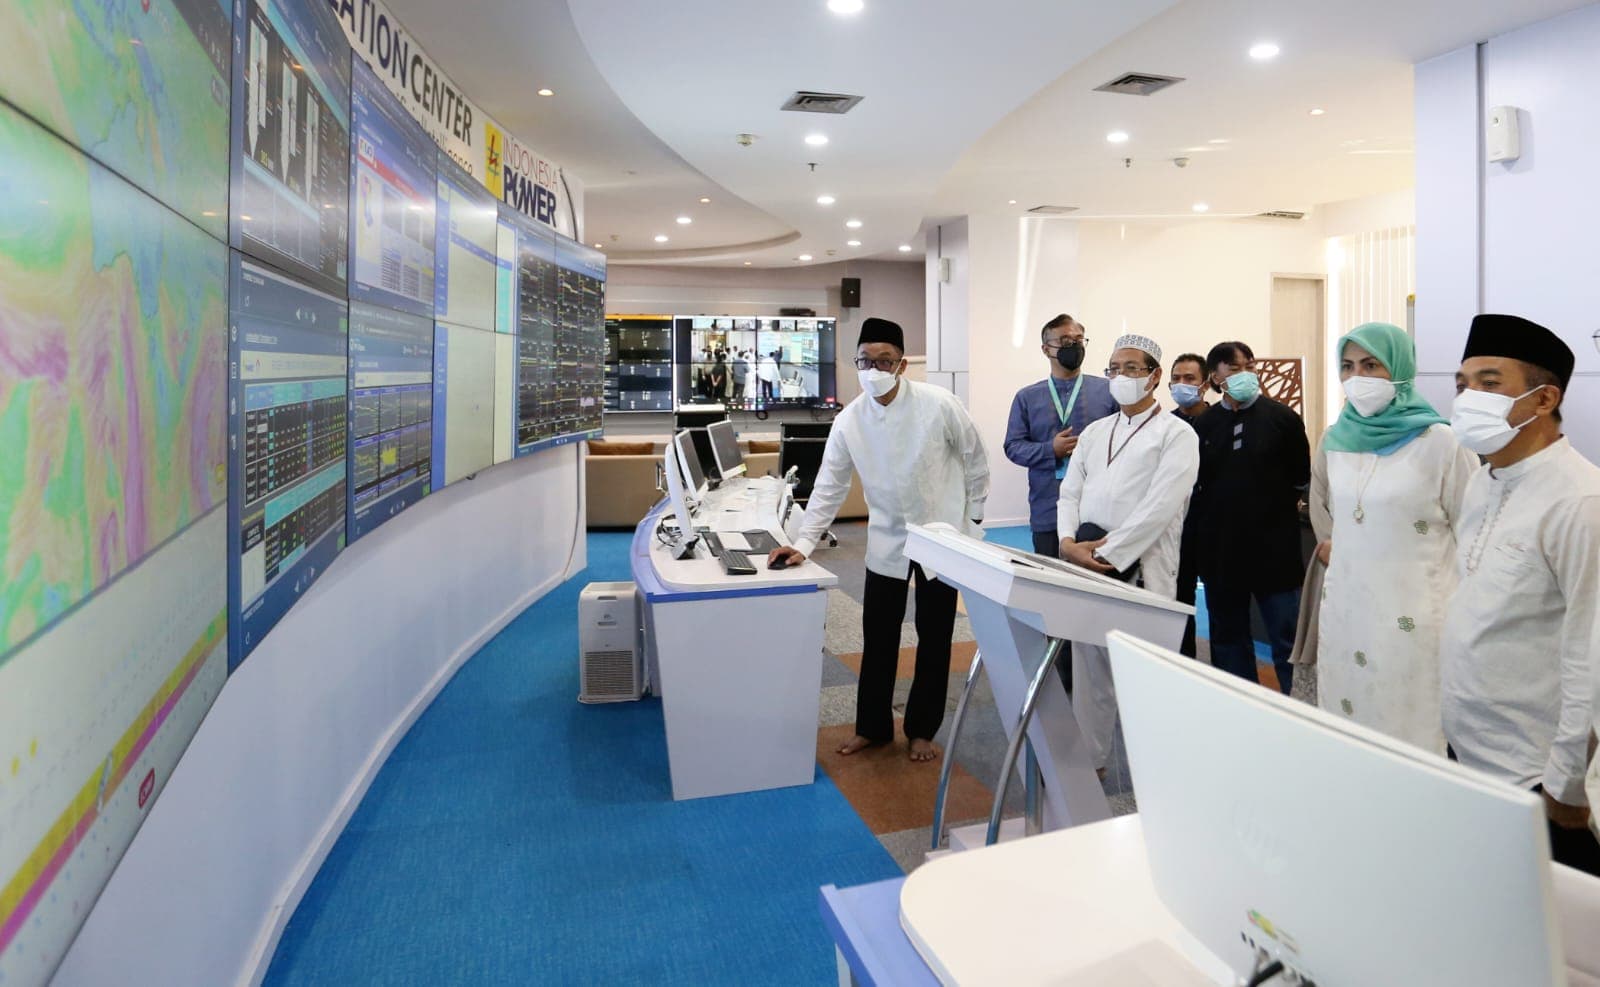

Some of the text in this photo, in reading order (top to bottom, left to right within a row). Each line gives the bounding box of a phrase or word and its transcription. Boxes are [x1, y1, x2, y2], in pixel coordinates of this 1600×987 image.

[330, 0, 408, 88] ATION
[411, 54, 472, 147] CENTER
[503, 135, 560, 193] INDONESIA
[503, 164, 557, 228] POWER
